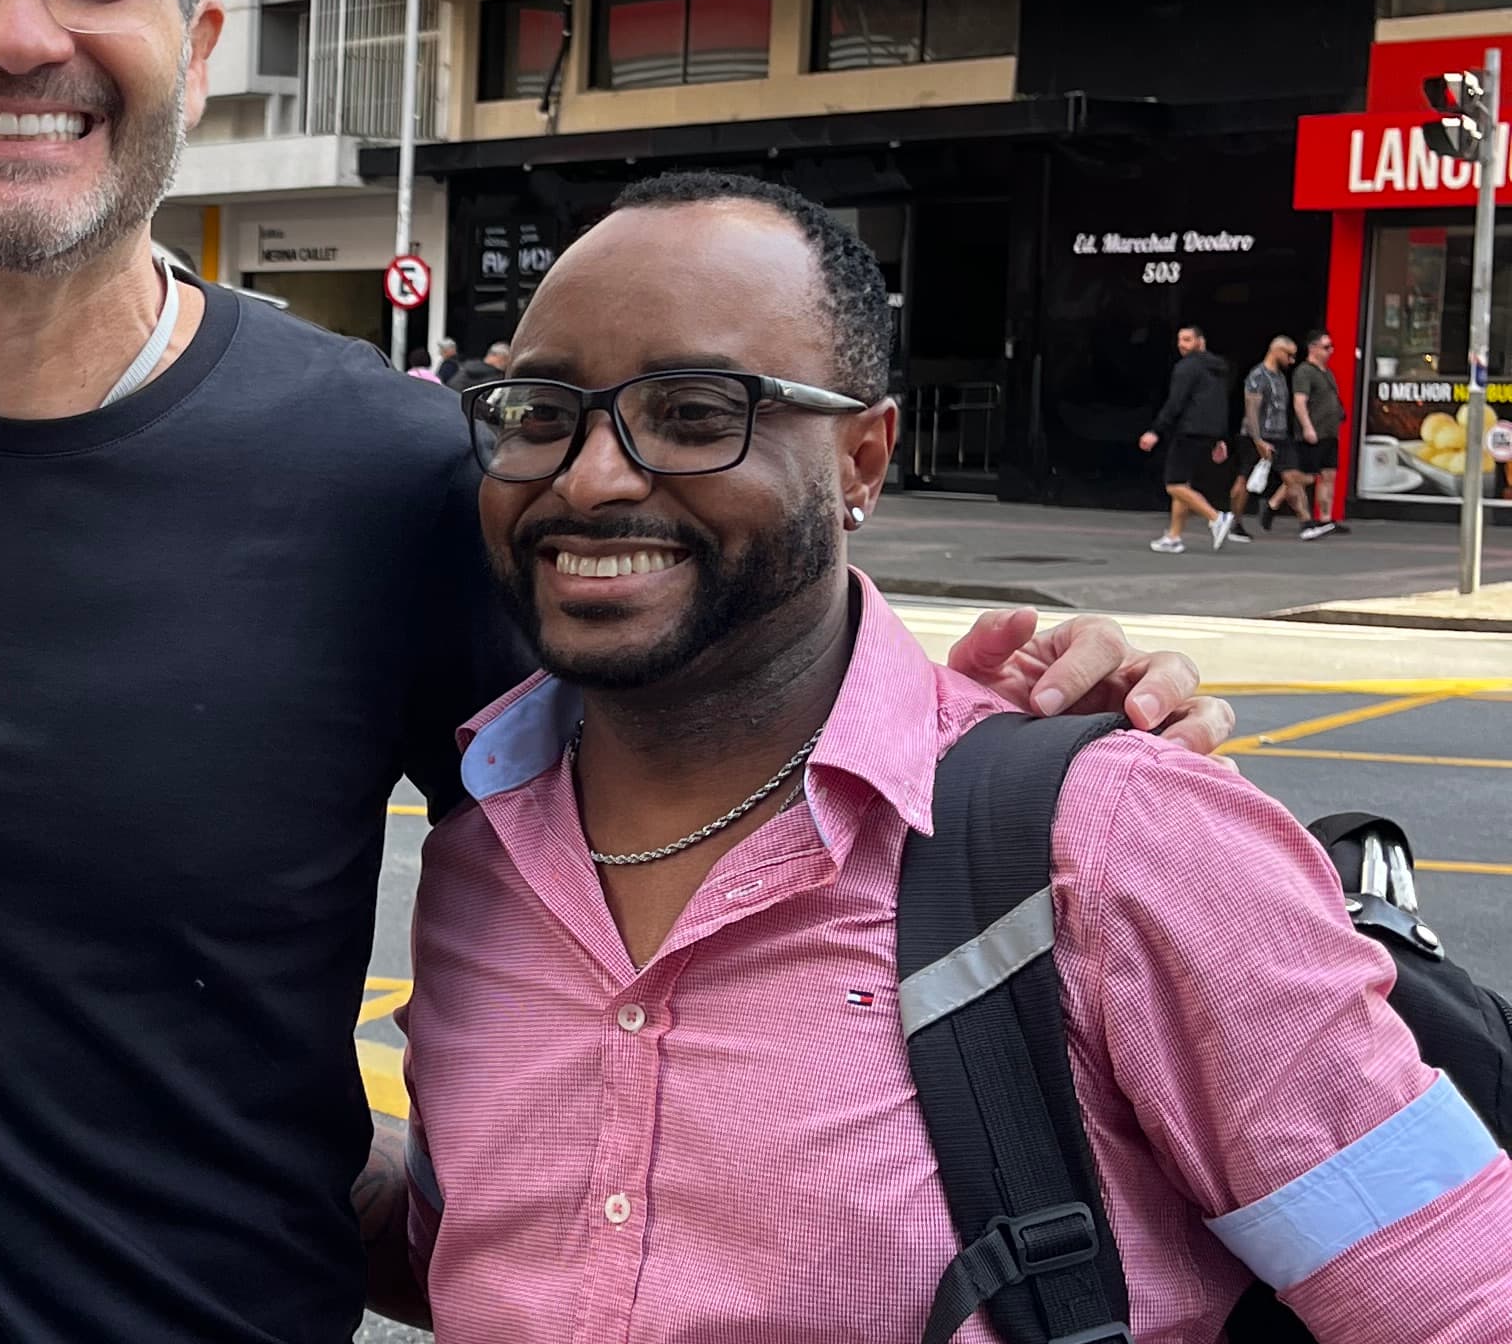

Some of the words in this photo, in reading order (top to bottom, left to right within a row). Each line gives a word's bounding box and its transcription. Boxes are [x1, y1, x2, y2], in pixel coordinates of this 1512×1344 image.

[1348, 121, 1512, 193] LANCH
[1101, 231, 1178, 254] Marechal
[1182, 230, 1255, 253] Deodoro
[1142, 260, 1182, 284] 503
[1391, 382, 1452, 403] MELHOR
